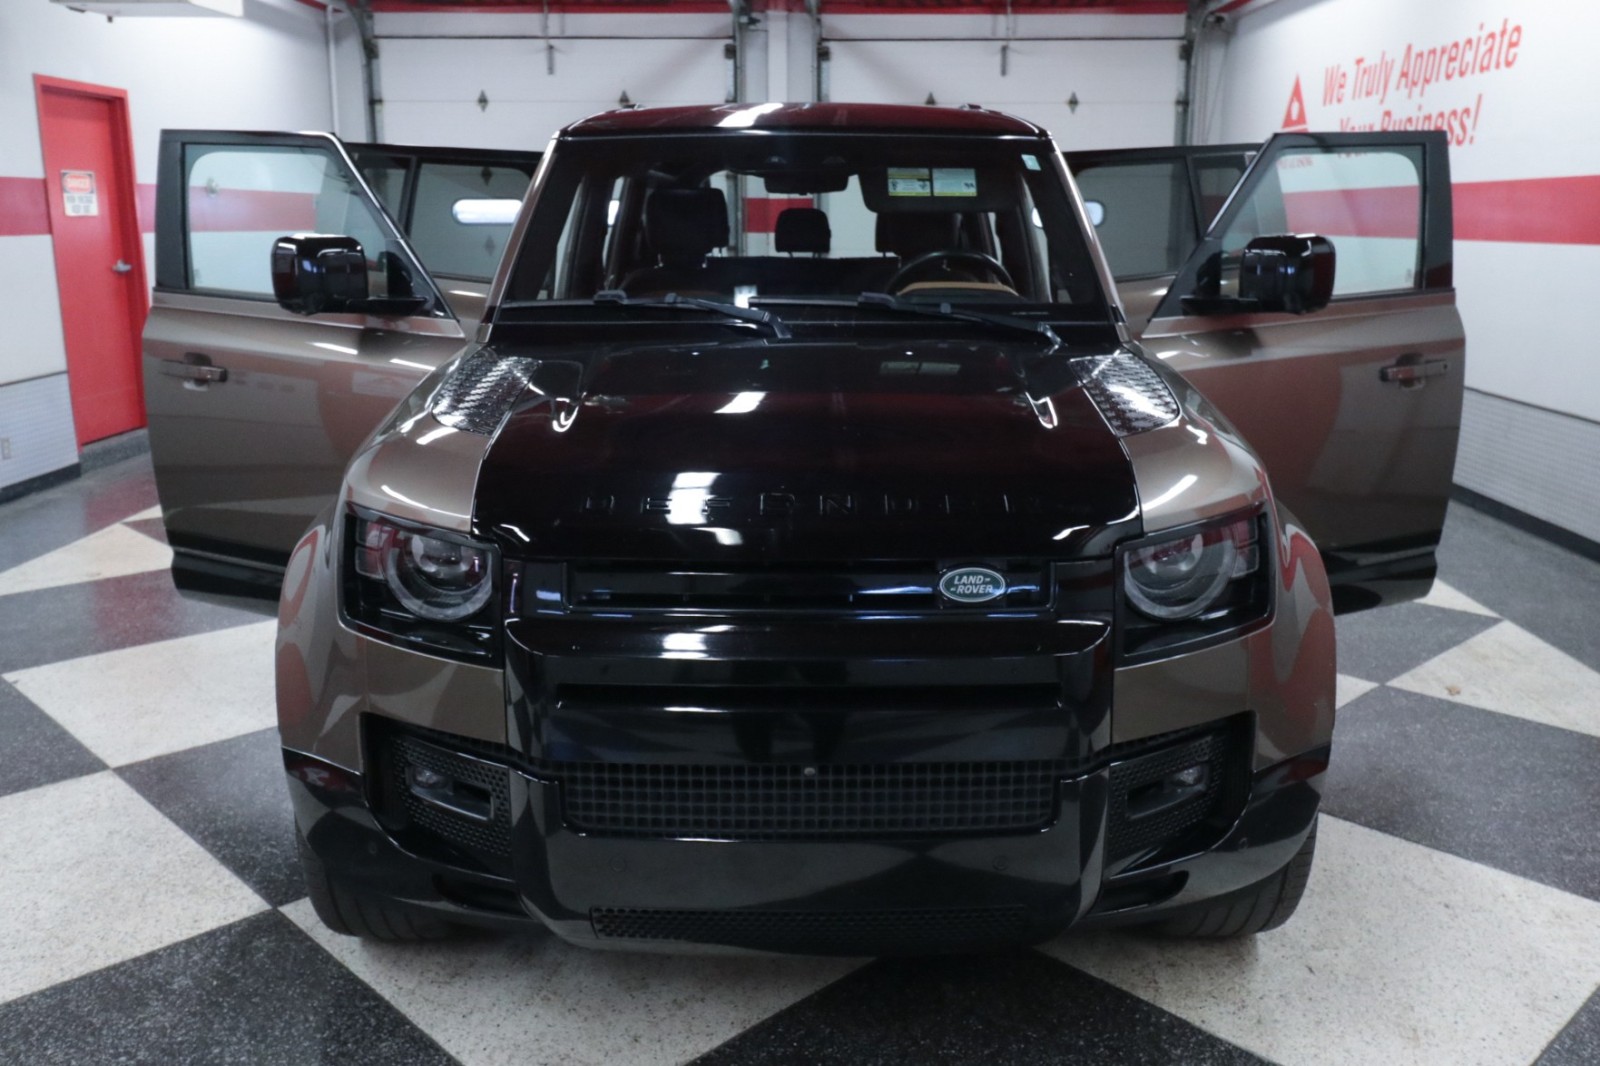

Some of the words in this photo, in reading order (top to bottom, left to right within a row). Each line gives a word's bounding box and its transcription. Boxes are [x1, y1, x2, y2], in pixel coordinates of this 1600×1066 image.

[1323, 64, 1347, 106] We
[1352, 51, 1395, 104] Truly
[1396, 18, 1522, 99] Appreciate
